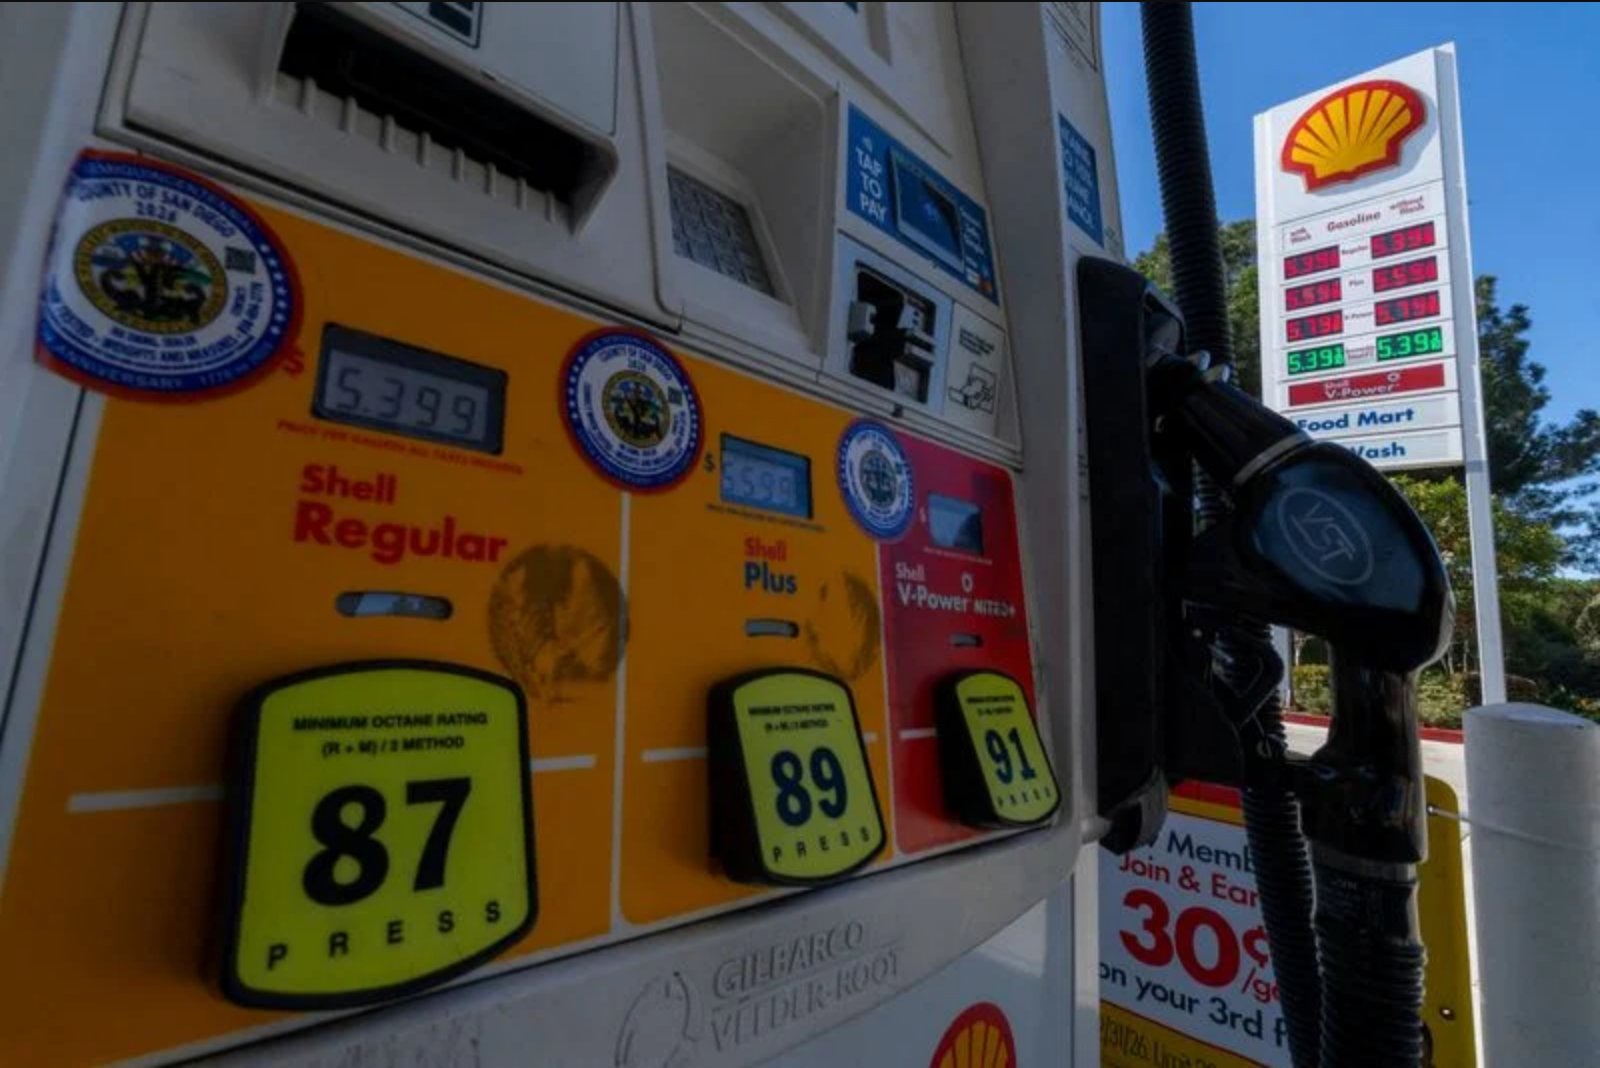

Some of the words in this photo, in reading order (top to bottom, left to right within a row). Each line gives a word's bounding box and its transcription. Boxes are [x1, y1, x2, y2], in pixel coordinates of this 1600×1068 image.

[856, 146, 882, 179] TAP
[860, 171, 882, 200] TO
[136, 184, 155, 199] OF
[161, 190, 191, 212] SAN
[192, 204, 236, 238] DIEGO
[860, 190, 889, 224] PAY
[1327, 211, 1382, 231] Gasoline
[1325, 384, 1394, 400] V-Power
[1297, 413, 1349, 432] Food
[1357, 408, 1415, 428] Mart
[704, 453, 714, 473] $
[300, 463, 396, 504] Shell
[293, 500, 508, 565] Regular
[744, 536, 787, 563] Shell
[744, 561, 798, 595] Plus
[895, 561, 926, 582] Shell
[897, 582, 968, 614] V-Power
[293, 715, 368, 731] MINIMUM
[371, 714, 431, 729] OCTANE
[437, 712, 487, 726] RATING
[402, 735, 465, 751] METHOD
[985, 727, 1037, 784] 91
[771, 746, 848, 827] 89
[301, 777, 473, 906] 87
[1119, 851, 1170, 883] Join
[1177, 865, 1201, 893] &
[266, 900, 502, 971] PRESS
[712, 920, 863, 999] GILBARCO
[1099, 961, 1127, 986] on
[1136, 976, 1200, 1015] your
[1209, 996, 1262, 1040] 3rd
